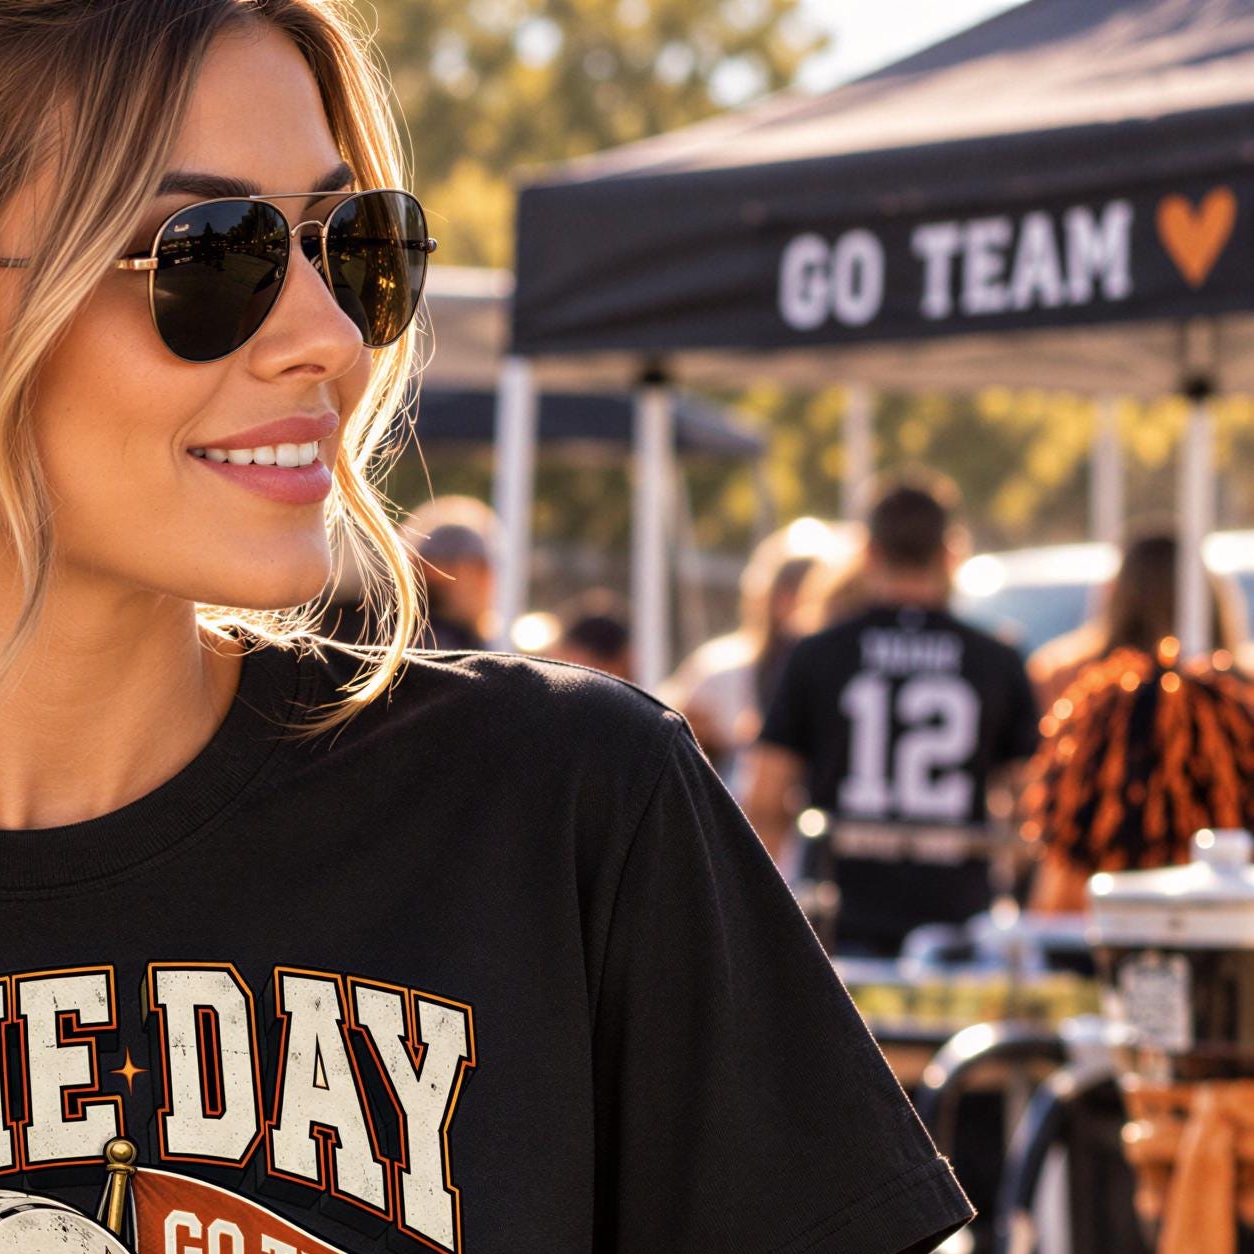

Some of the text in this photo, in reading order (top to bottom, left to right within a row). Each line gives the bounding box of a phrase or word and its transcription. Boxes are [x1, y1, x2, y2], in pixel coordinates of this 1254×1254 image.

[779, 200, 1135, 329] GO TEAM
[838, 671, 981, 818] 12
